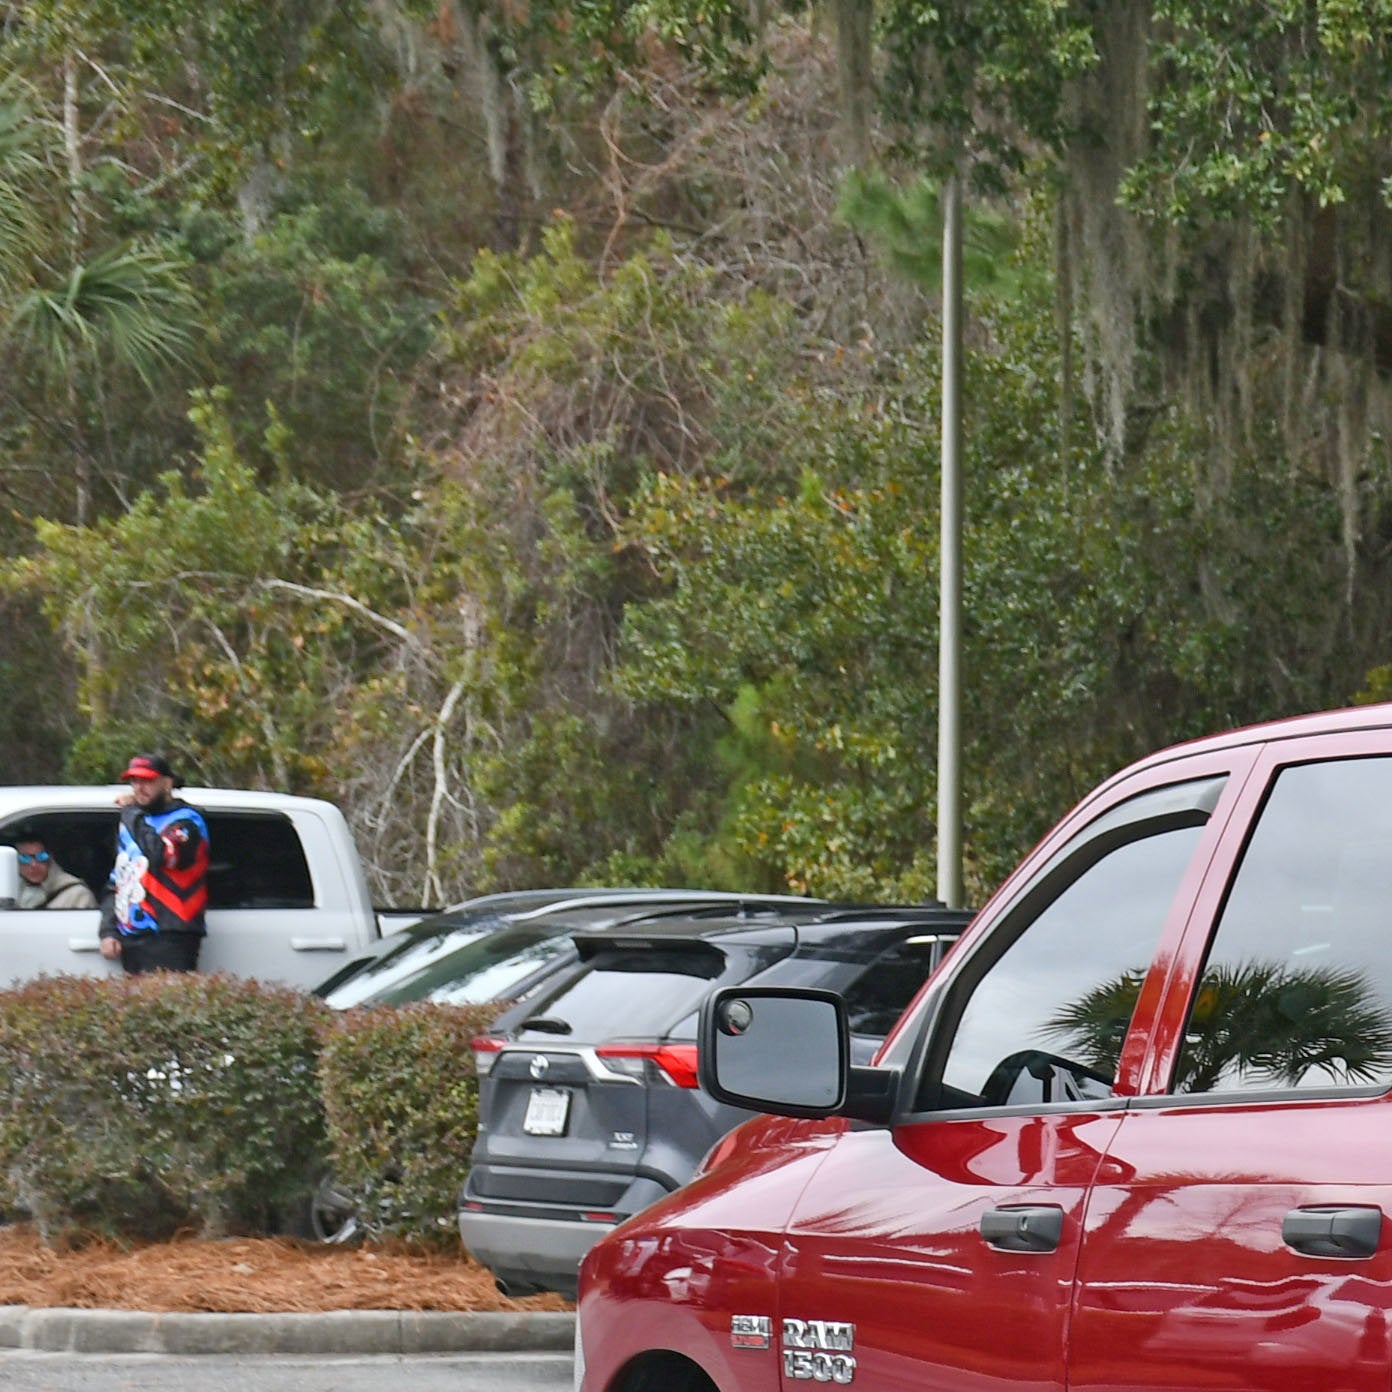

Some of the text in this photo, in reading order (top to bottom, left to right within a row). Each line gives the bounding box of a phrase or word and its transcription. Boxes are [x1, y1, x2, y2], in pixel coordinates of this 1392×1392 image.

[732, 1315, 772, 1334] HEMI
[783, 1318, 856, 1351] RAM
[783, 1349, 856, 1384] 1500
